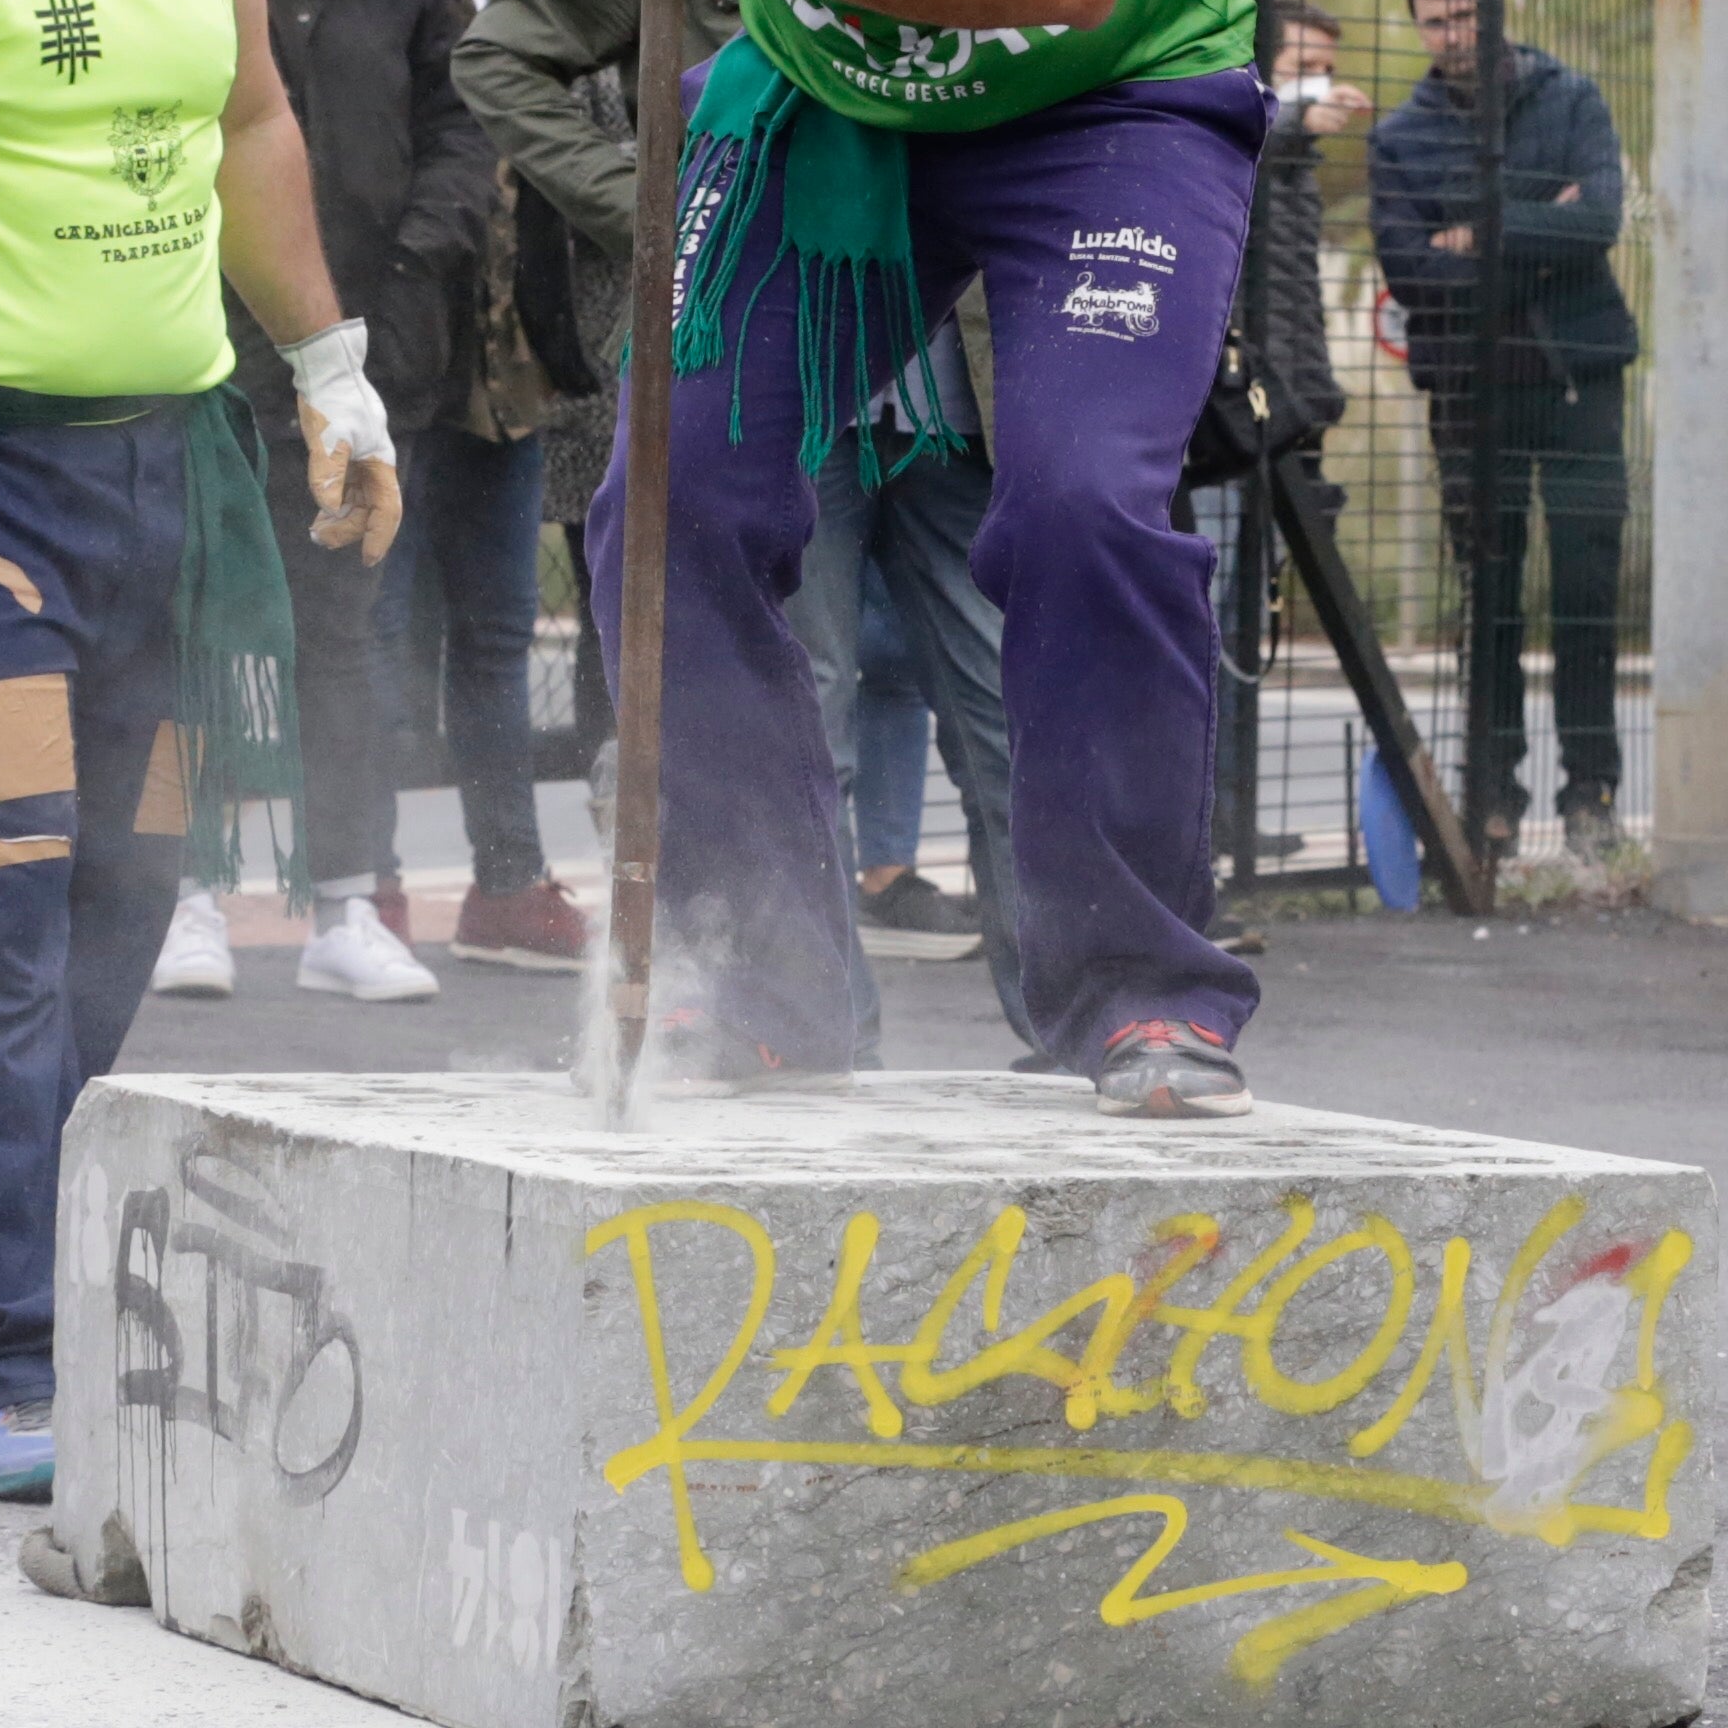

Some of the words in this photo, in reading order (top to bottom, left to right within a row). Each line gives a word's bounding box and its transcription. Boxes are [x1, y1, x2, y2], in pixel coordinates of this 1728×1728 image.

[905, 81, 986, 102] BEERS
[54, 215, 178, 240] CARNICERIA
[1072, 296, 1154, 313] Pokabroma
